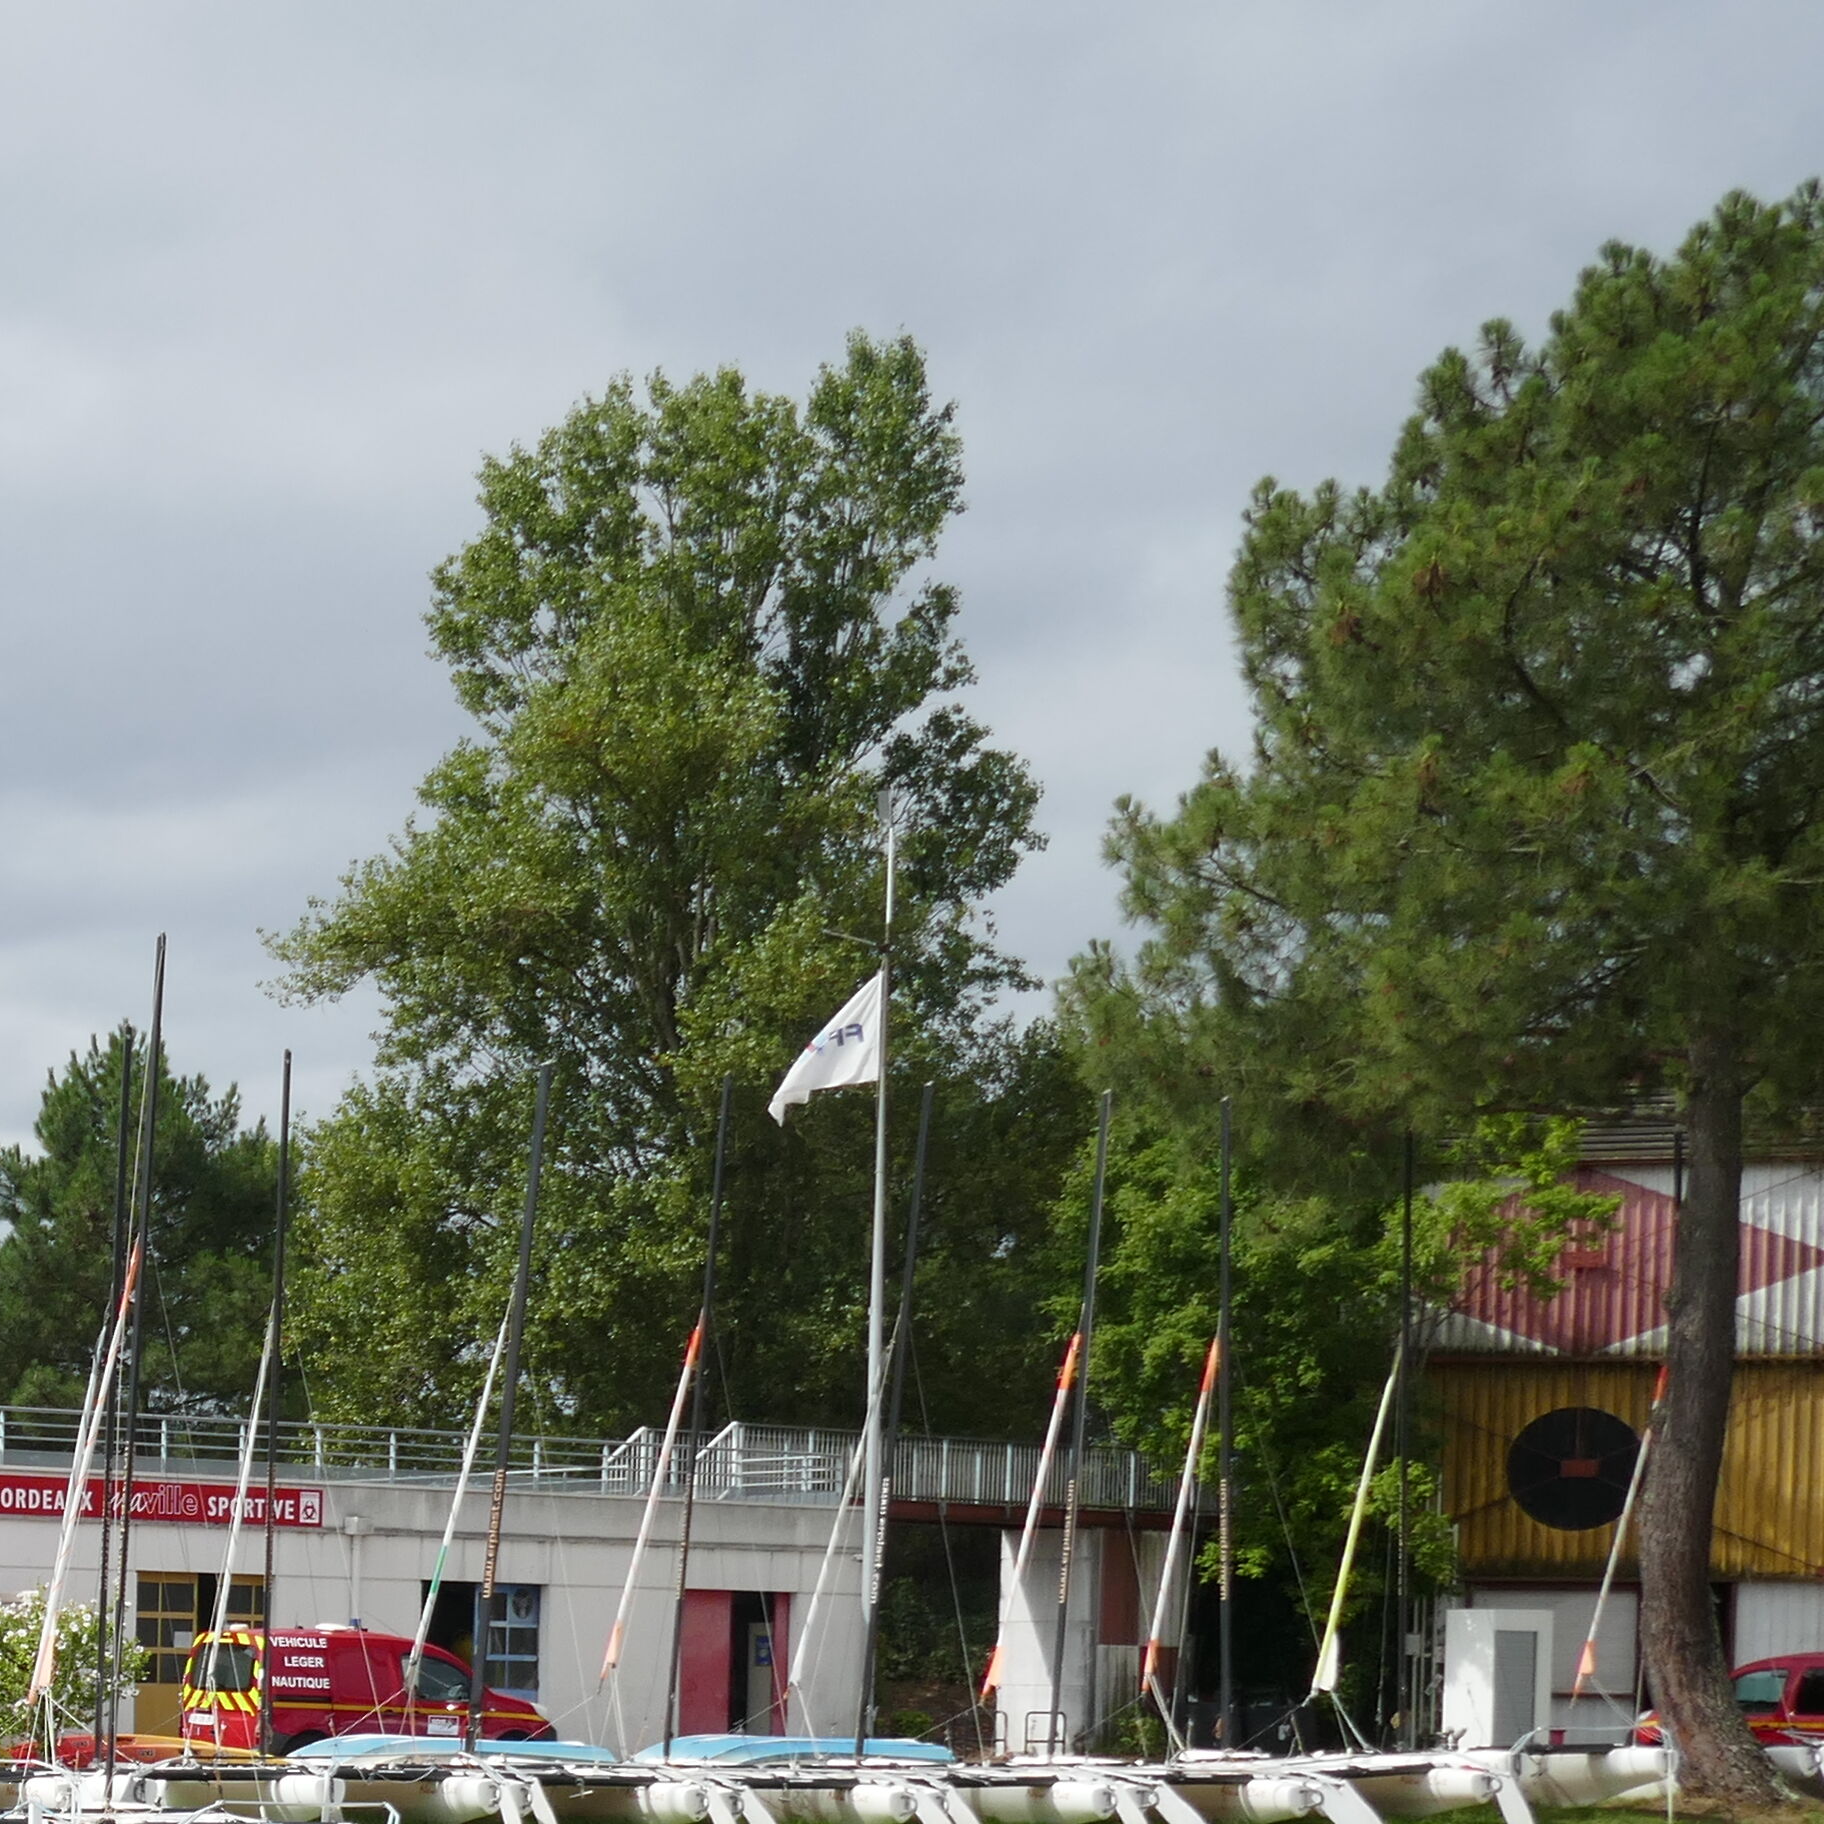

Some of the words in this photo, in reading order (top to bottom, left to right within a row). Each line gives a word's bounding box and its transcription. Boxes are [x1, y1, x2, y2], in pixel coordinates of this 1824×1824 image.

[207, 1496, 295, 1520] SPORTVE
[482, 1468, 506, 1599] www.erplast.com
[269, 1636, 328, 1649] VEHICULE
[284, 1656, 324, 1668] LEGER
[271, 1675, 331, 1689] NAUTIQUE
